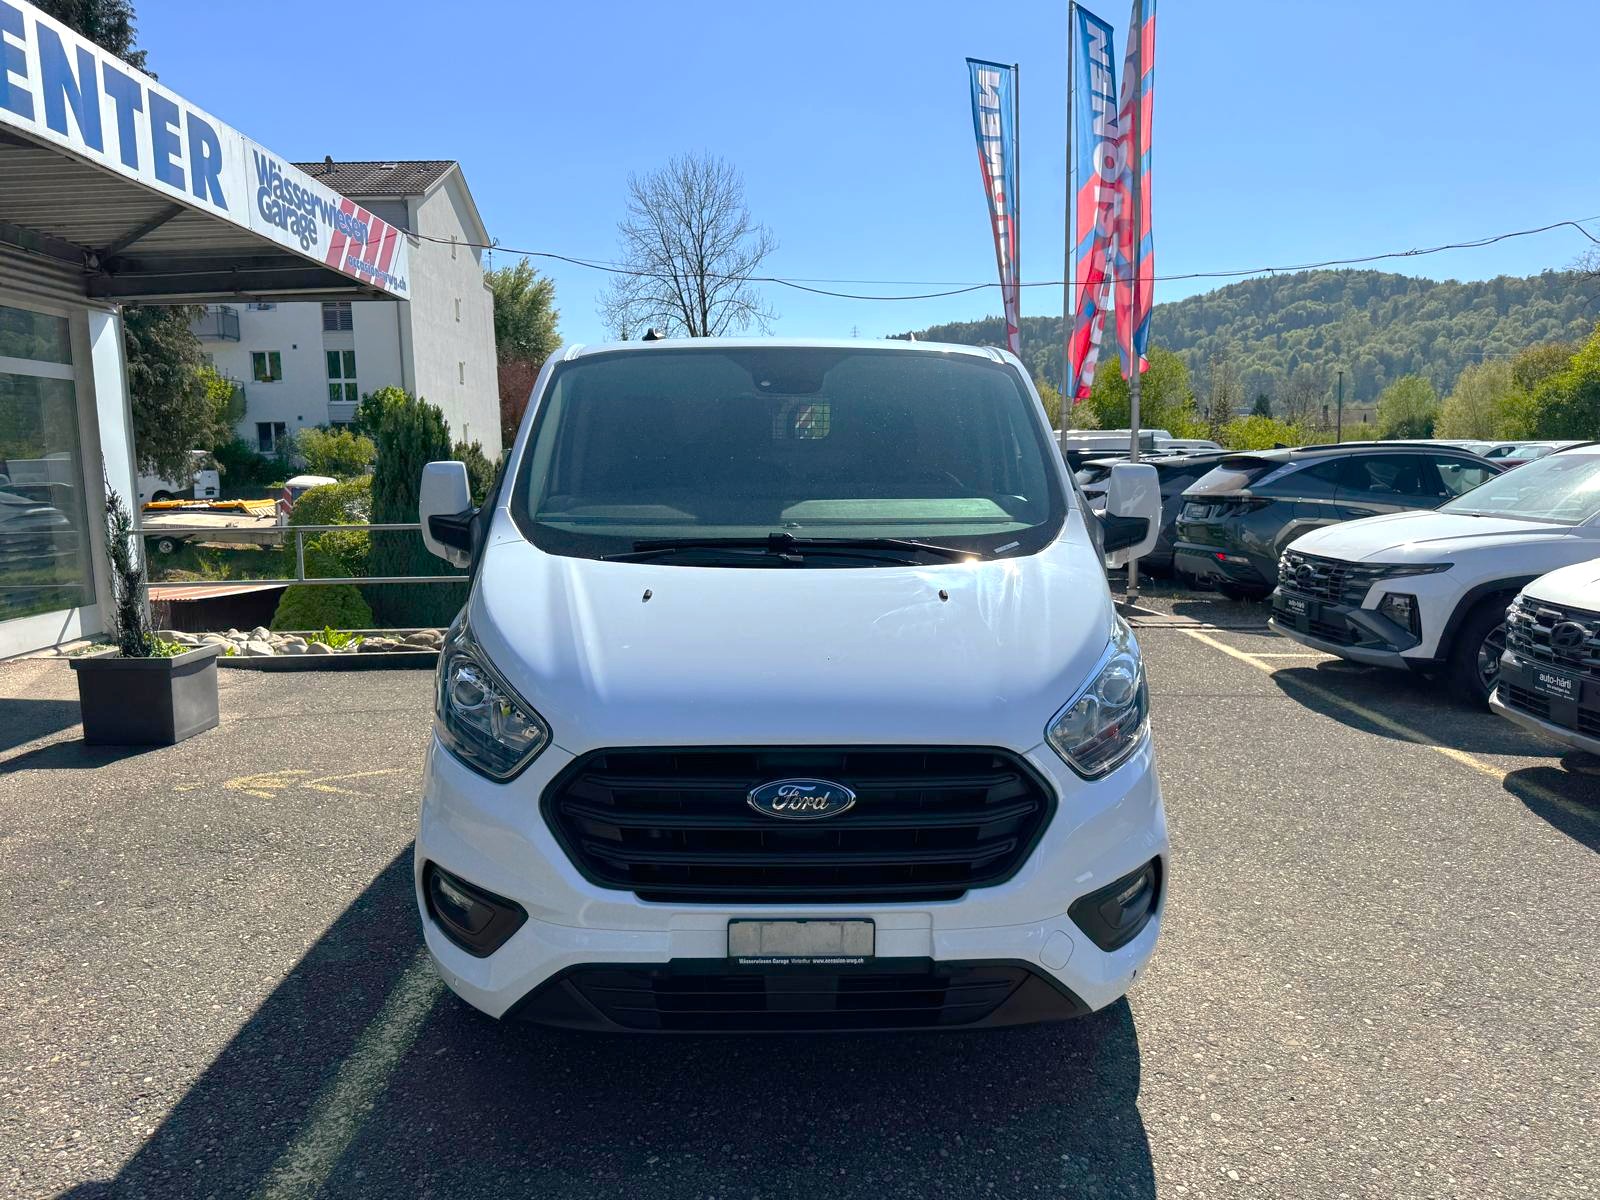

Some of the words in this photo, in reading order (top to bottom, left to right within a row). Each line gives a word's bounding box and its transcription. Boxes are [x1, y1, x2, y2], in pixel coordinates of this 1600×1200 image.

[0, 0, 229, 211] ENTER
[253, 149, 368, 246] Wässerwiesen
[257, 186, 318, 251] Garage
[772, 785, 831, 810] Ford
